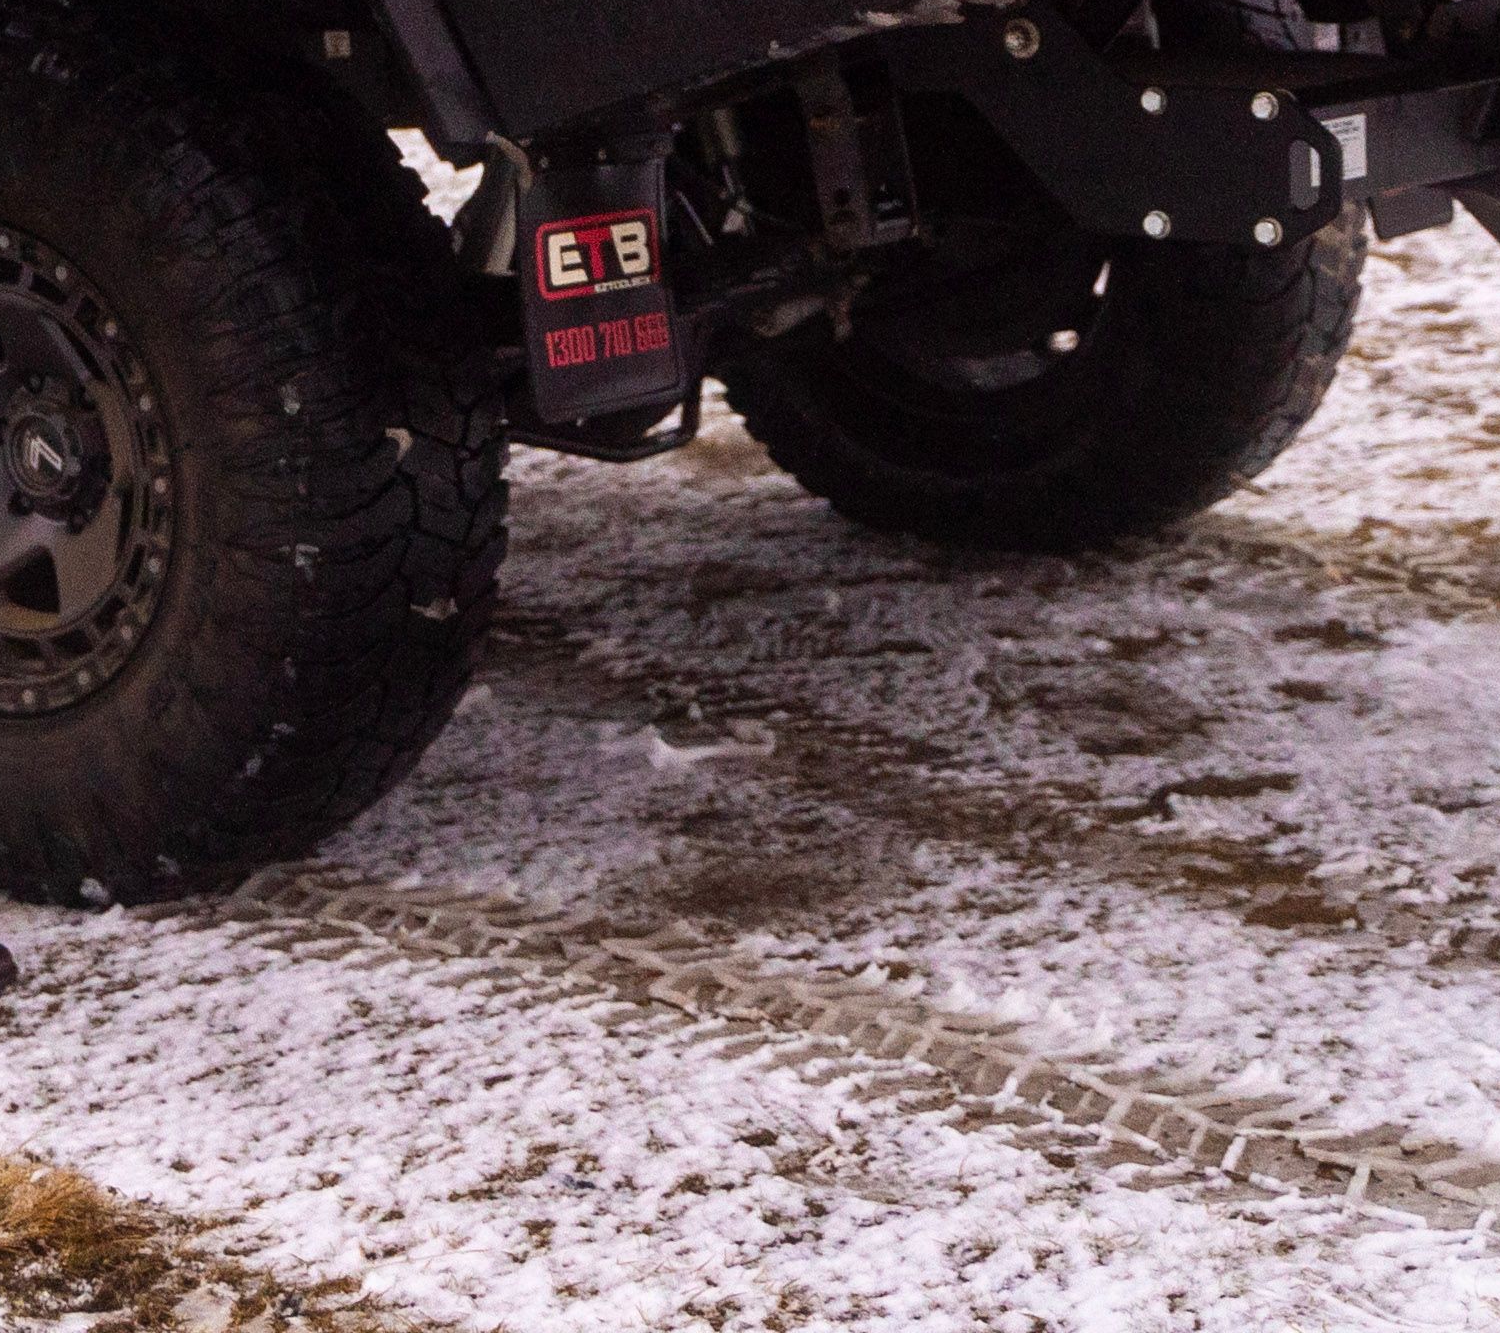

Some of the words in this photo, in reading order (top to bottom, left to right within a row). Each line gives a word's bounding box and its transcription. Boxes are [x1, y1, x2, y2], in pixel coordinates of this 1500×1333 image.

[548, 221, 650, 286] ETB
[546, 325, 596, 367] 1300
[598, 319, 632, 358] 710
